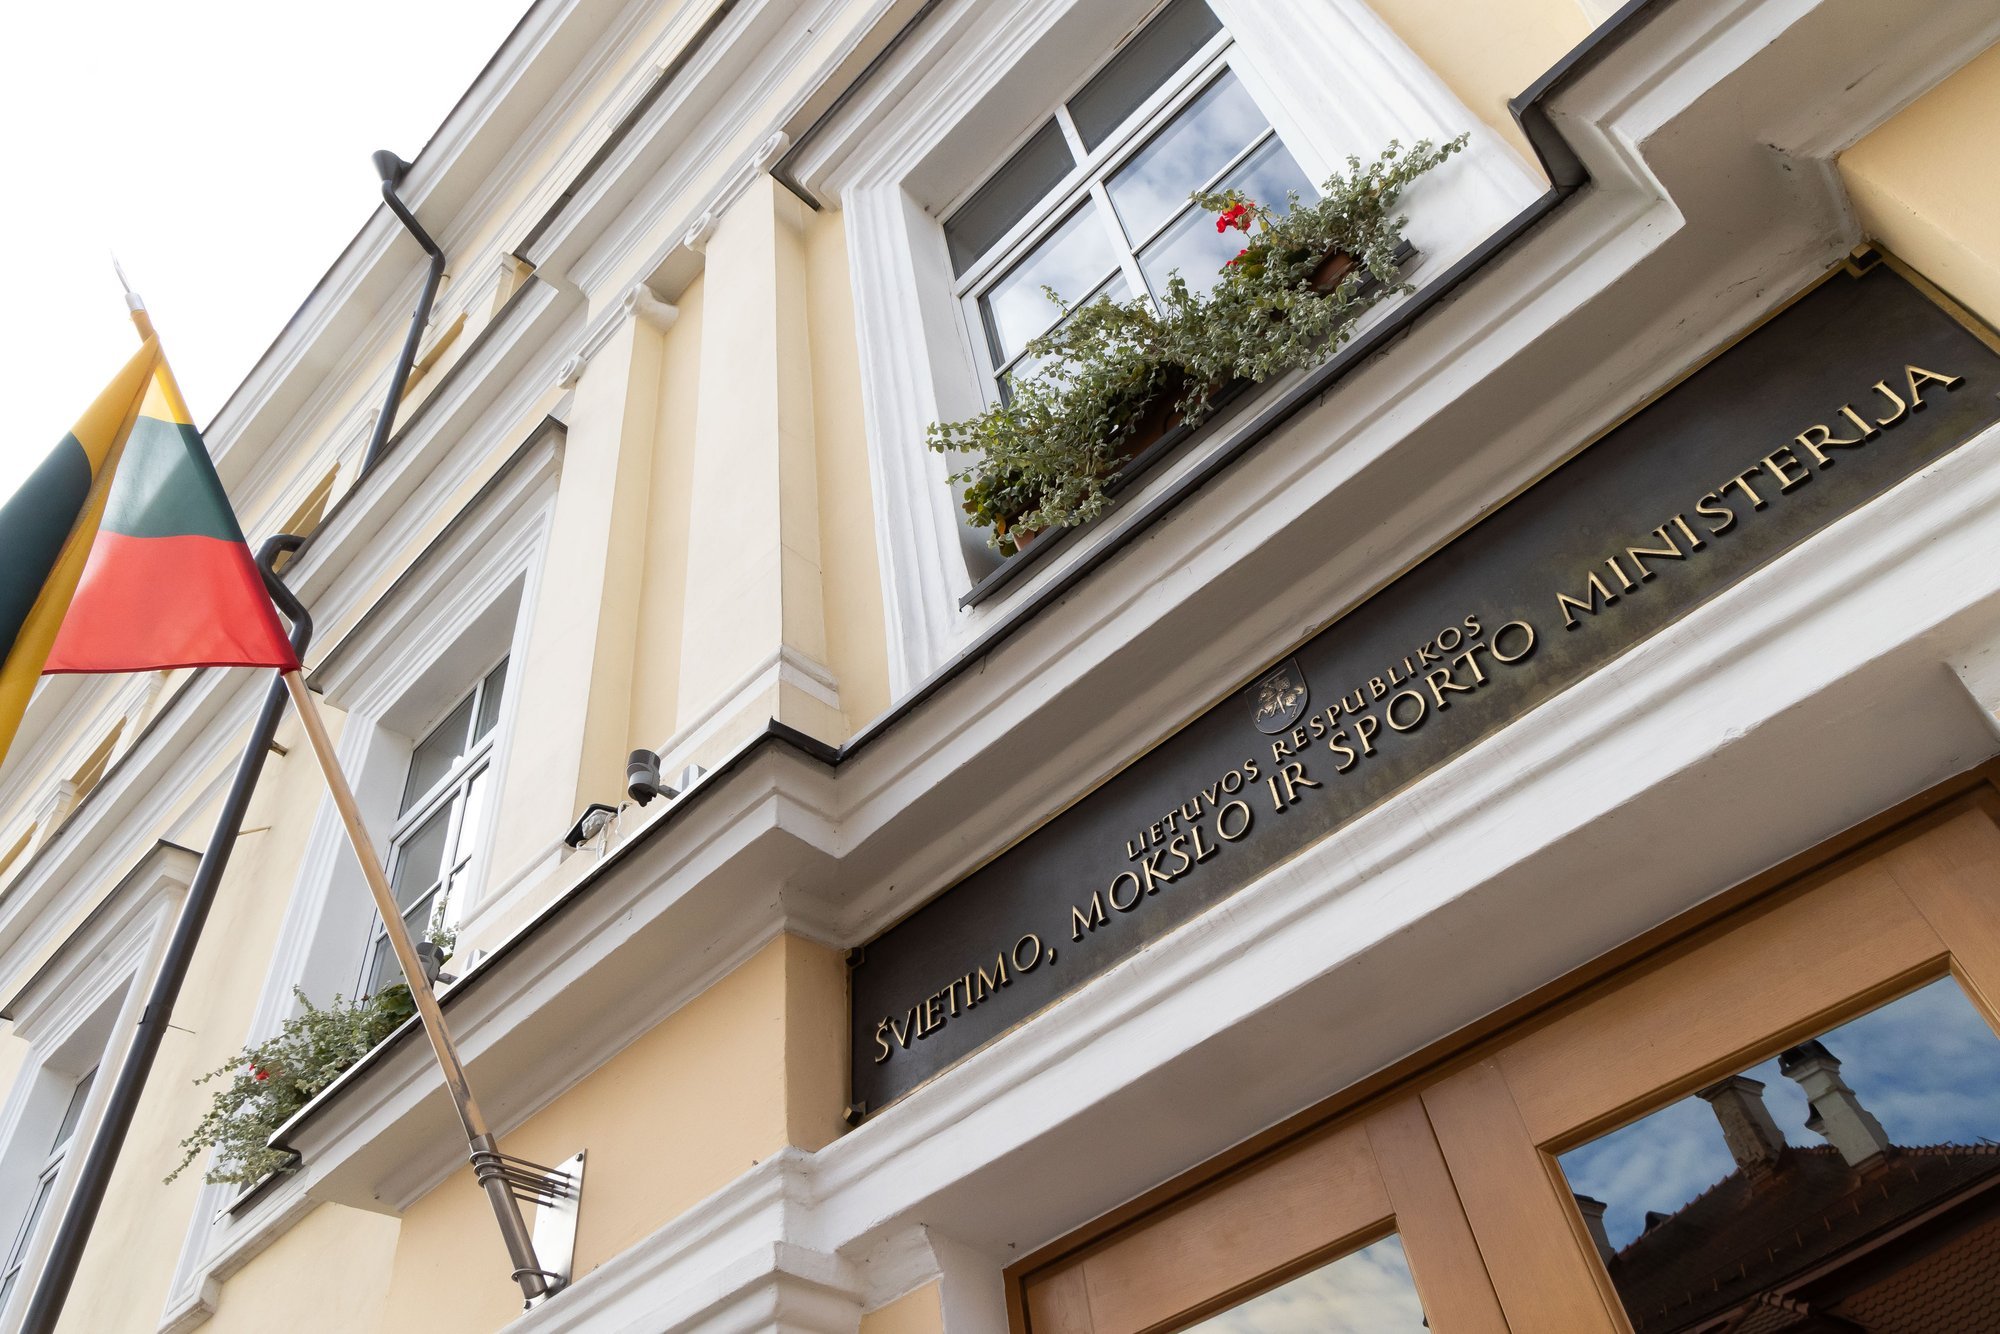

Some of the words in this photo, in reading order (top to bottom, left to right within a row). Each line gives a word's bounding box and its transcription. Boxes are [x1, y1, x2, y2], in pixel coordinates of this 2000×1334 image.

[874, 933, 1055, 1063] ŠVIETIMO,
[1071, 800, 1251, 940] MOKSLO
[1266, 761, 1319, 811] IR
[1328, 620, 1535, 771] SPORTO
[1556, 364, 1964, 628] MINISTERIJA
[1126, 758, 1259, 859] LIETUVOS
[1271, 614, 1482, 763] RESPUBLIKOS
